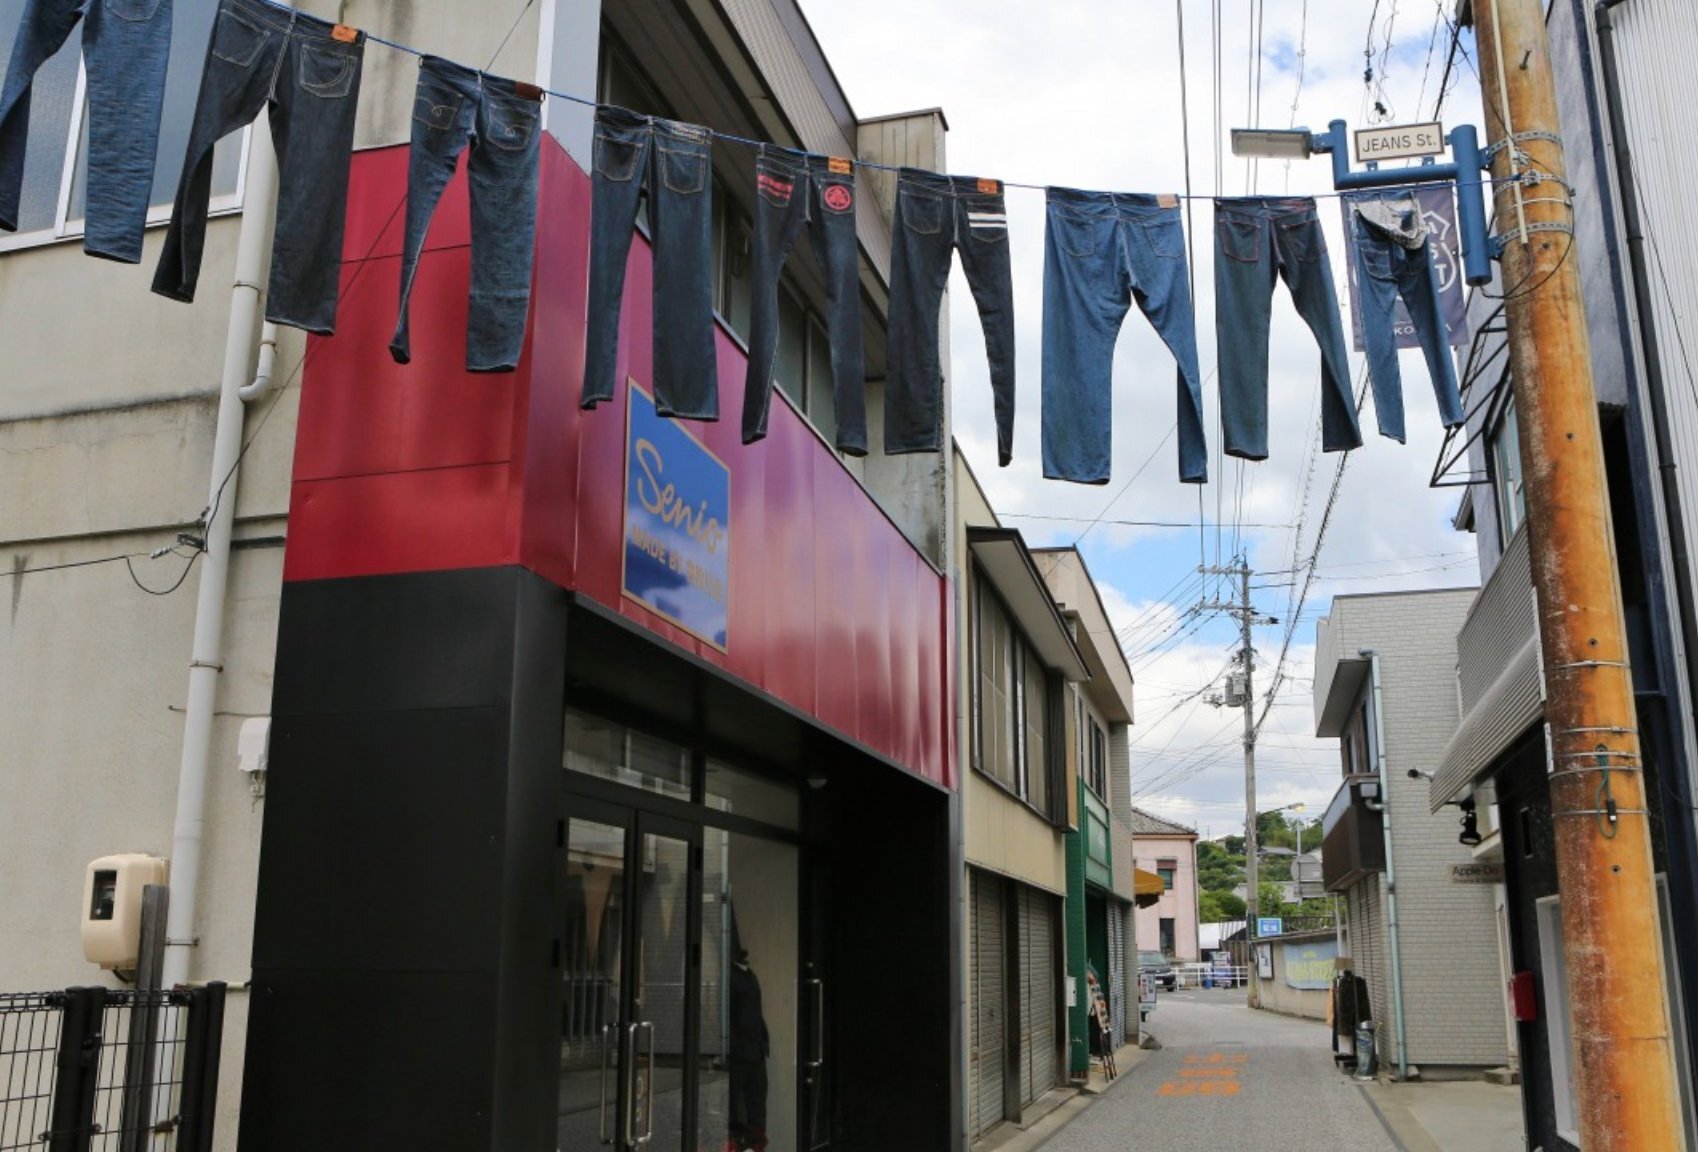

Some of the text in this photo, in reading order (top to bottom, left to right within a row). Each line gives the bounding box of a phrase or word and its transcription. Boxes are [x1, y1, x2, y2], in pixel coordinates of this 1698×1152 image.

[1362, 133, 1436, 152] JEANS St.
[635, 438, 723, 555] Senio
[632, 523, 666, 565] MADE
[1452, 865, 1481, 878] Apple
